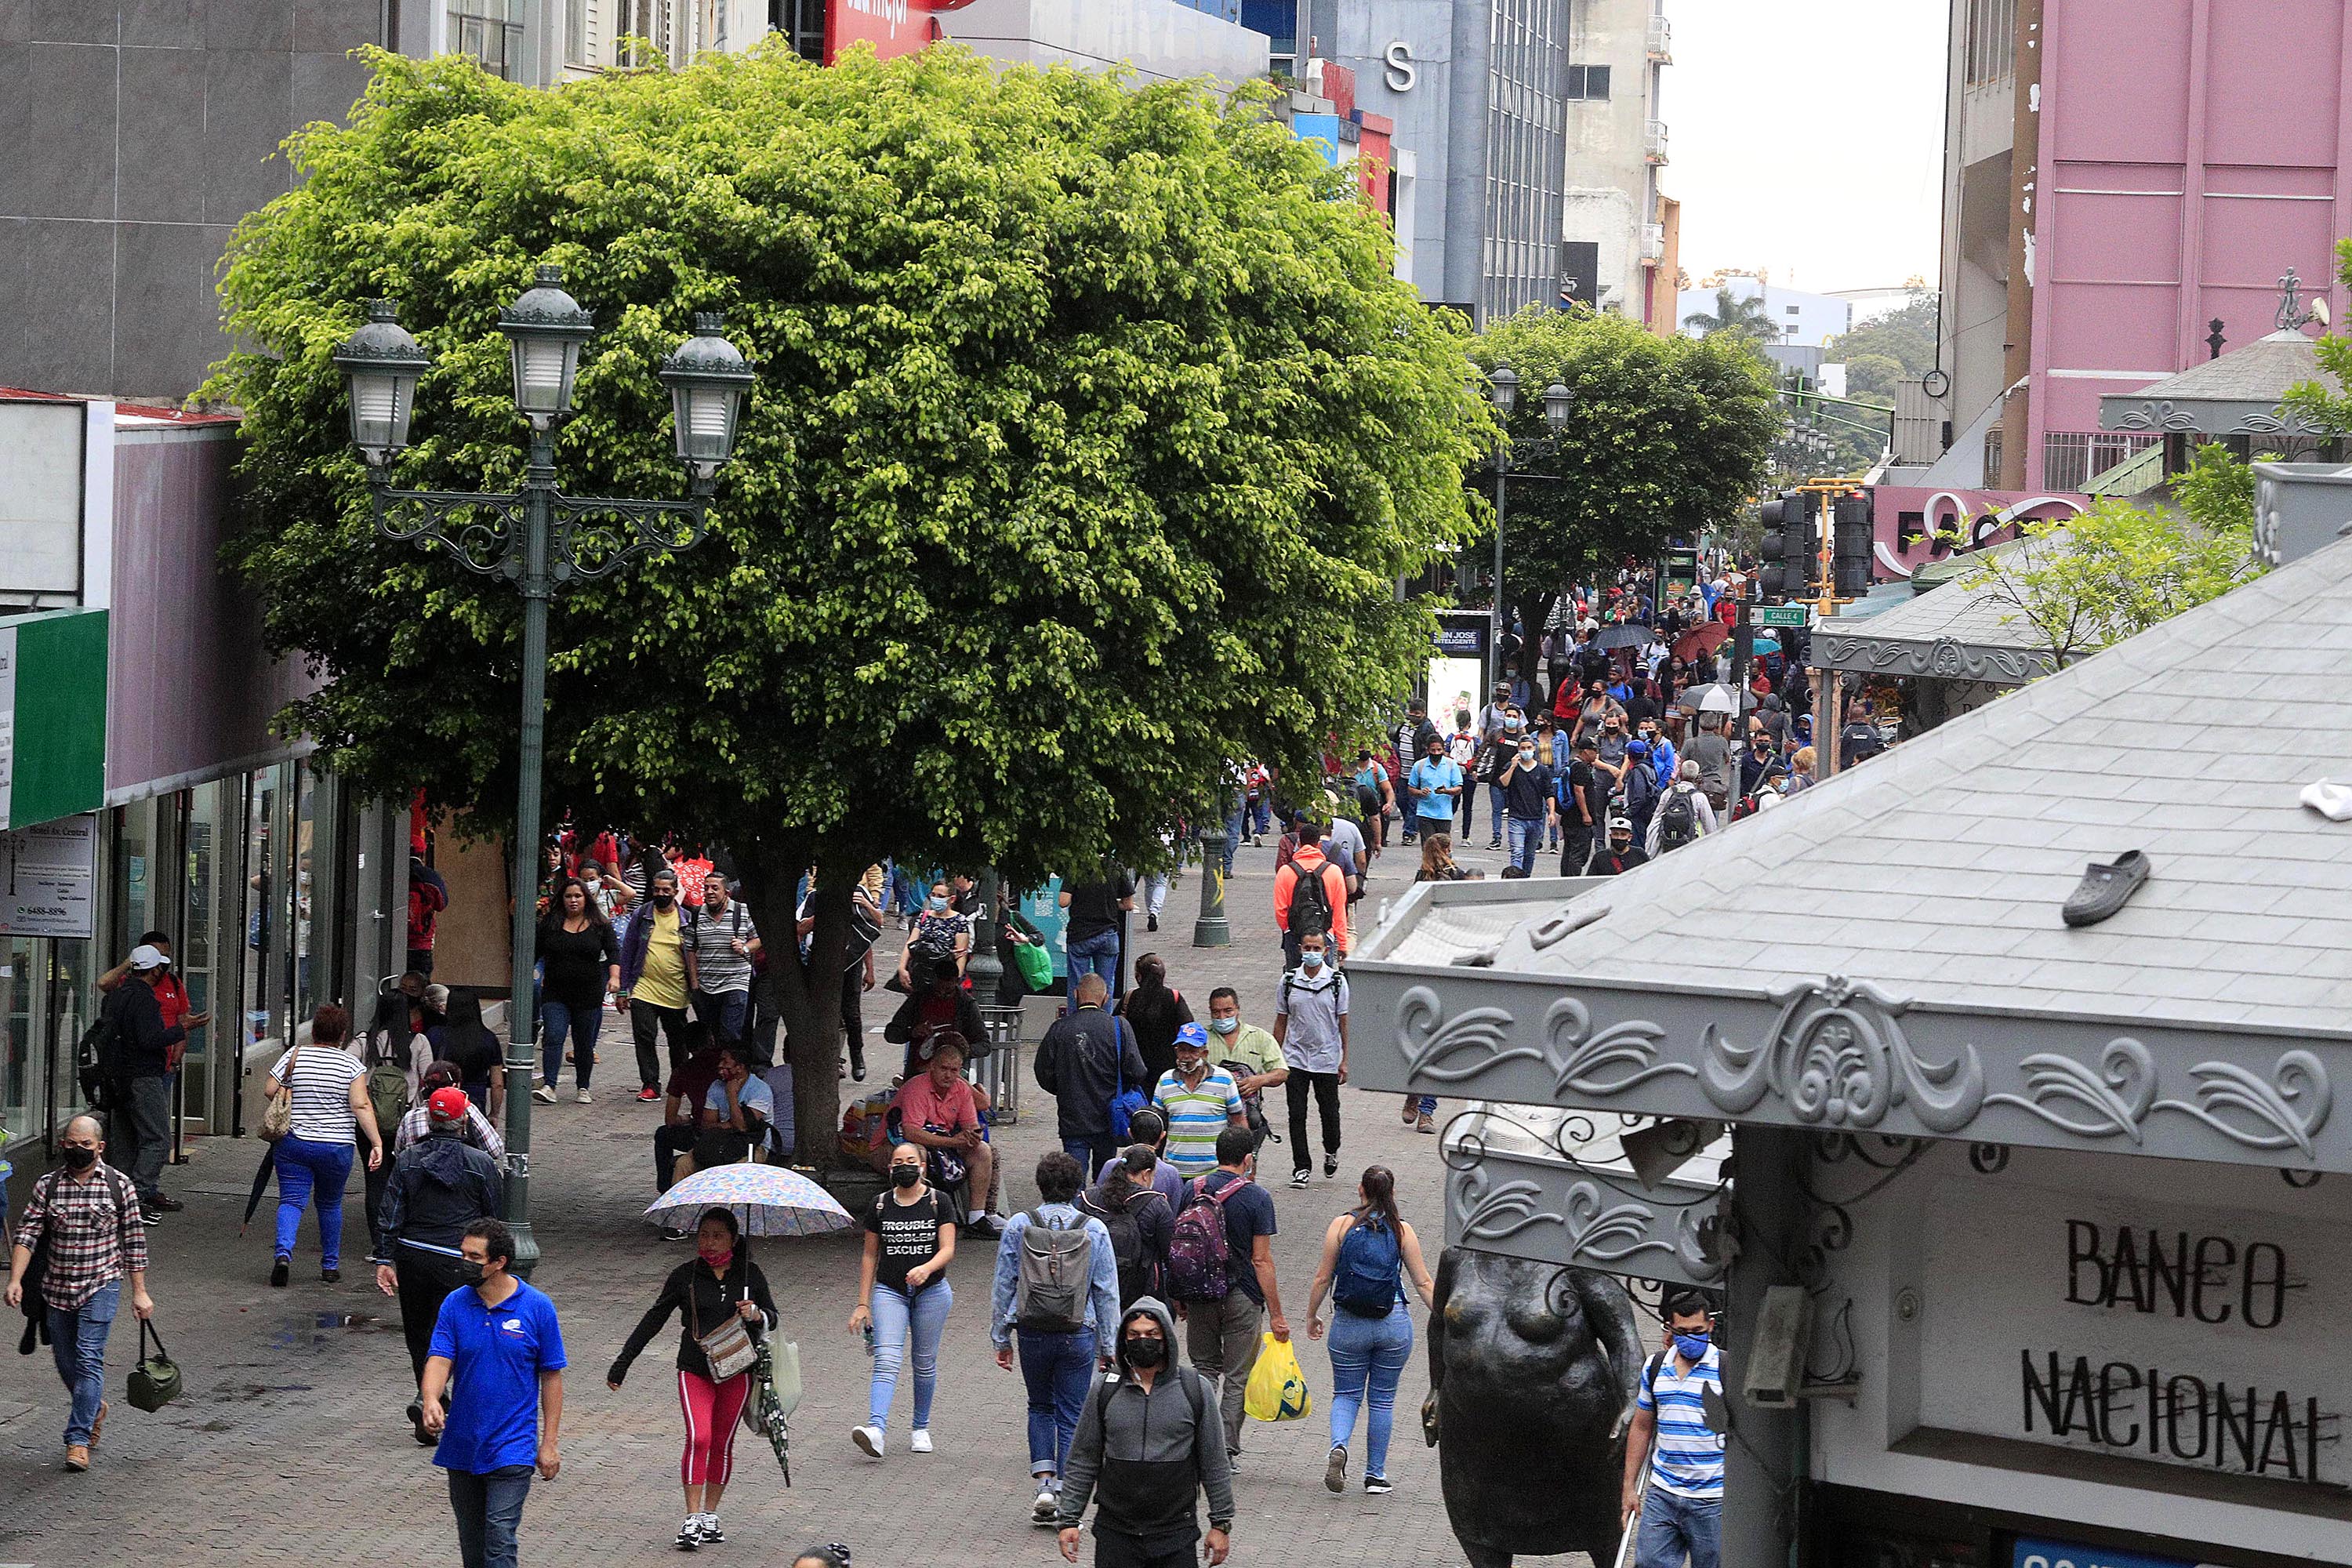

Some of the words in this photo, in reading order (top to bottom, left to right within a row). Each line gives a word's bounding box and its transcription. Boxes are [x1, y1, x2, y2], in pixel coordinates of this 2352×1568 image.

[1386, 42, 1416, 91] S
[882, 1219, 935, 1231] TROUBLE
[887, 1244, 932, 1255] EXCUSE
[2065, 1219, 2285, 1329] BANCO
